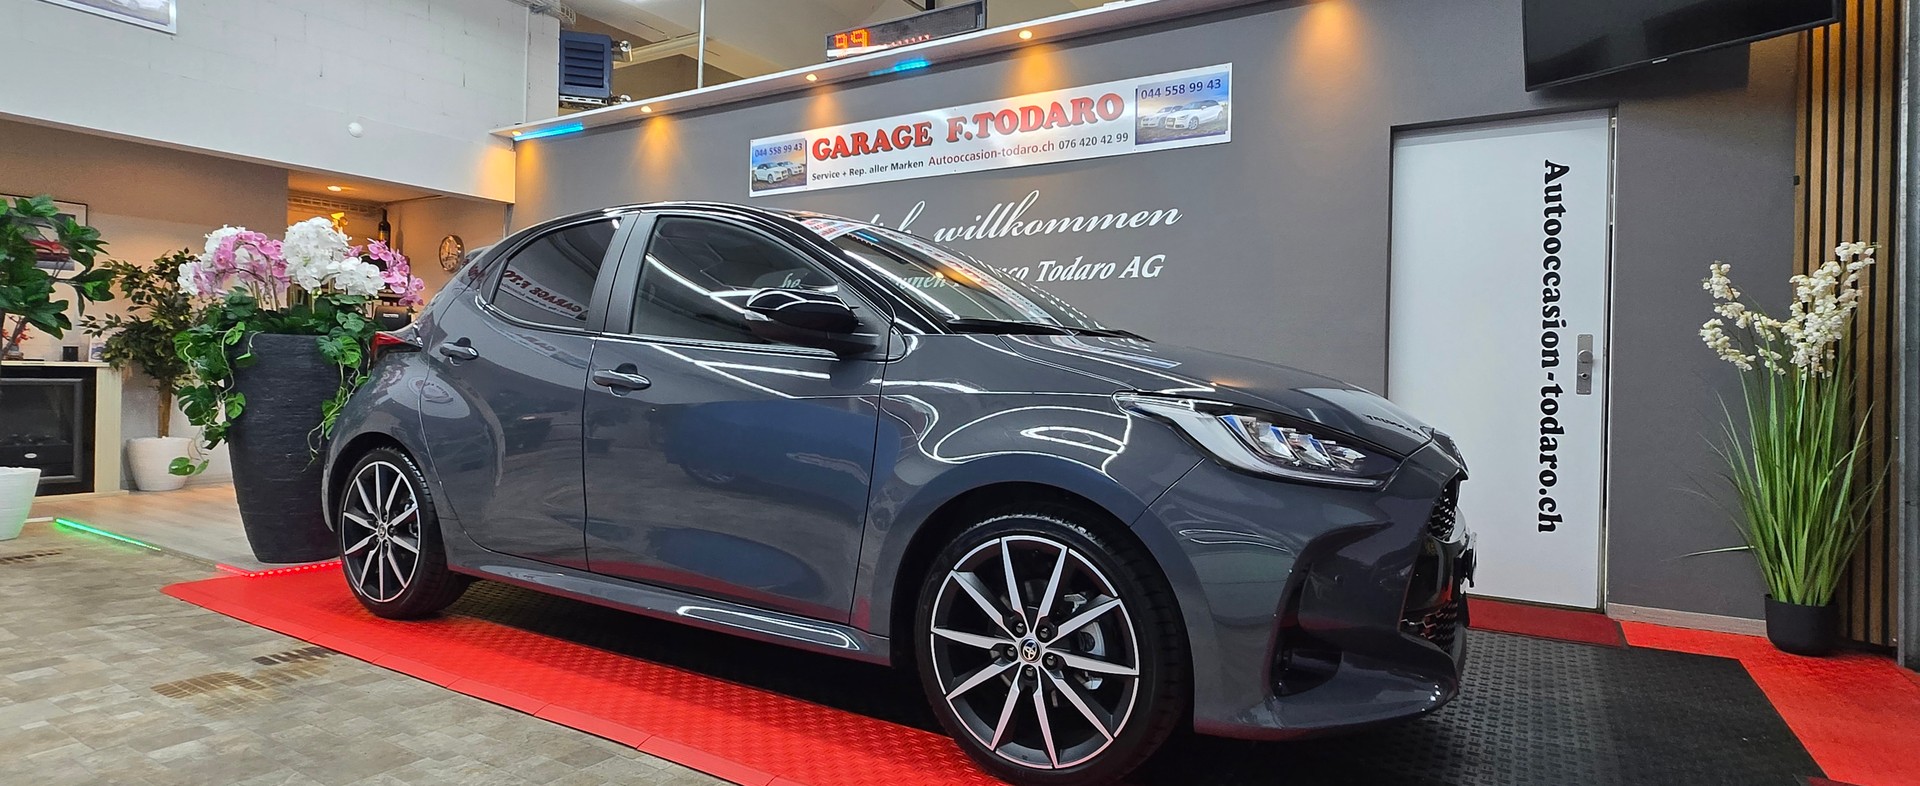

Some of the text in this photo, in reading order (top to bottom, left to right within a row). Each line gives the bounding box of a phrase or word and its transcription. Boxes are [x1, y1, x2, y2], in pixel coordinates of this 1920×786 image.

[1141, 79, 1221, 99] 044 558 99 43
[755, 142, 803, 158] 044 558 99 43
[812, 93, 1125, 161] GARAGE F.TODARO
[812, 171, 840, 181] Service
[849, 168, 867, 178] Rep.
[869, 164, 887, 174] aller
[891, 160, 923, 171] Marken
[928, 141, 1055, 166] Autooccasion-todaro.ch
[1059, 139, 1076, 150] 076
[1079, 136, 1097, 147] 420
[1100, 134, 1113, 145] 42
[1116, 132, 1129, 142] 99
[933, 190, 1183, 242] willkommen
[1035, 256, 1116, 282] Todaro
[1118, 254, 1166, 279] AG
[1538, 159, 1570, 533] Autooccasion-todaro.ch
